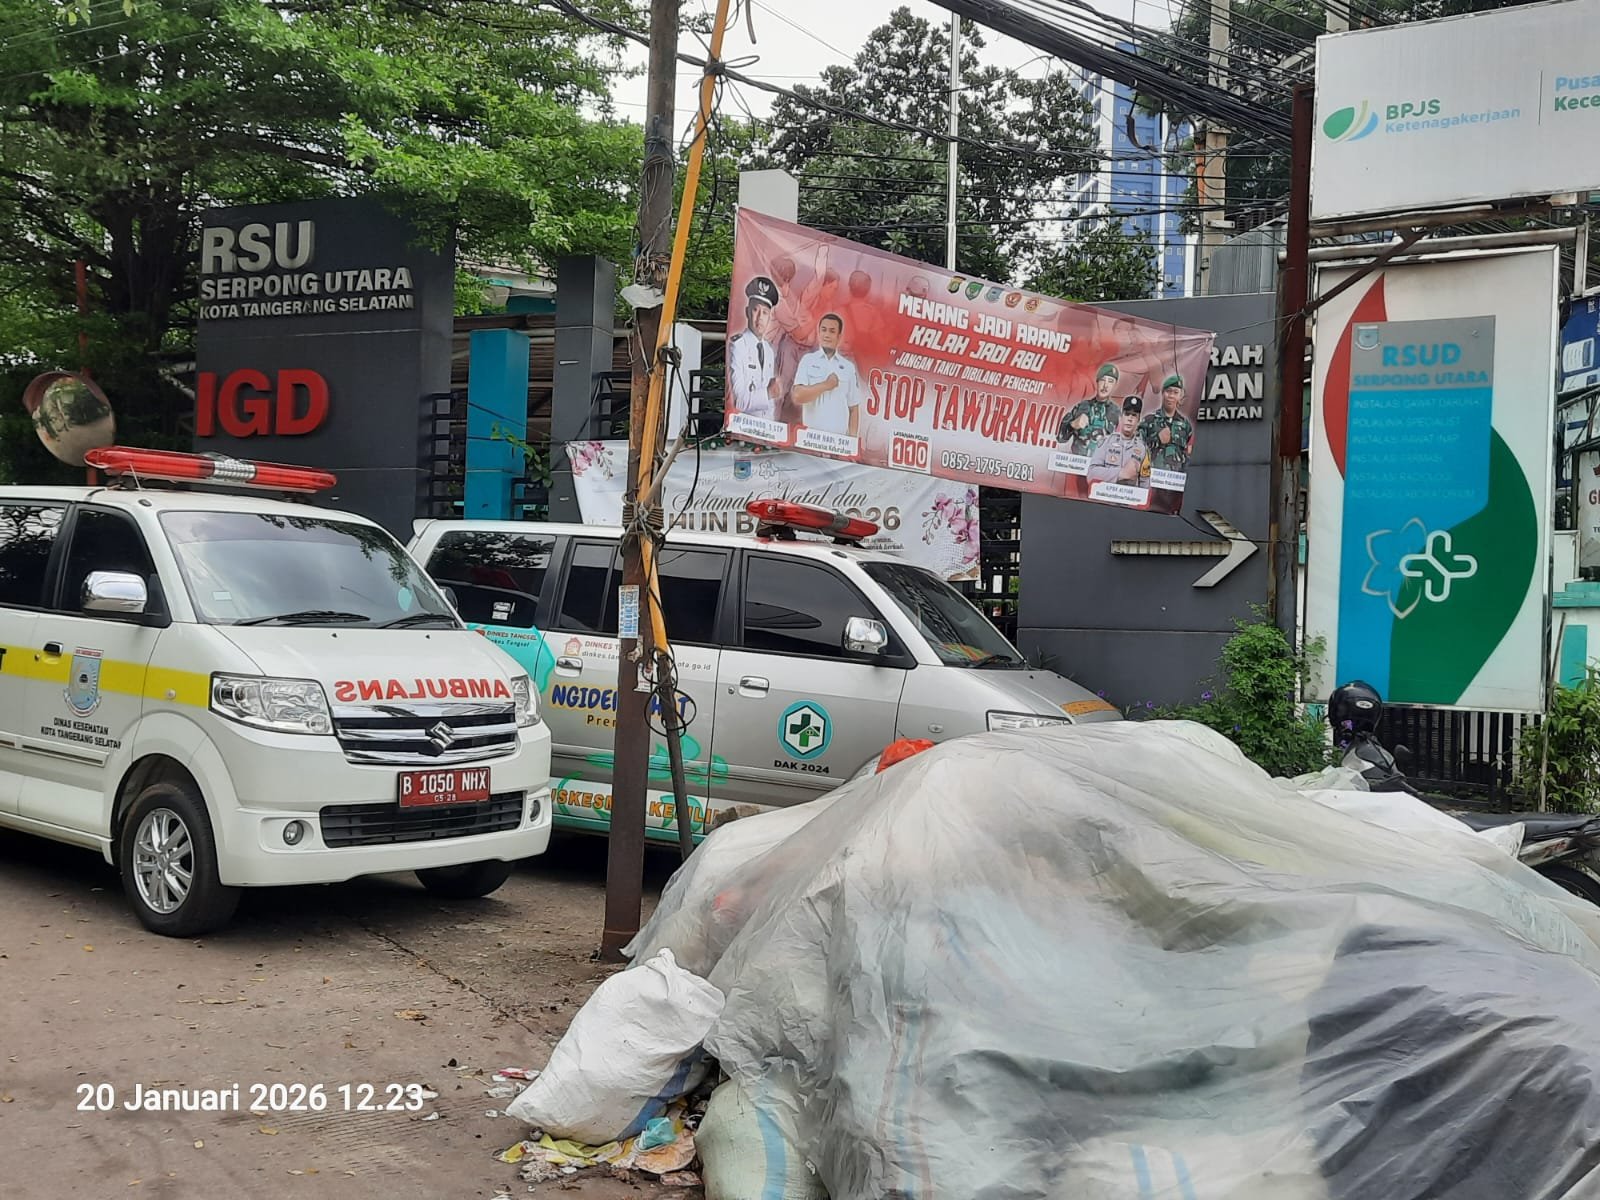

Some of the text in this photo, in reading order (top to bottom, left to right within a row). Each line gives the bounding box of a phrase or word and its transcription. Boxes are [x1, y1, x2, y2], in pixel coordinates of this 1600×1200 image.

[1385, 107, 1521, 134] Ketenagakerjaan
[1386, 99, 1441, 120] BPJS
[202, 220, 314, 274] RSU
[201, 267, 414, 300] SERPONG UTARA
[200, 294, 414, 319] KOTA TANGERANG SELATAN
[898, 293, 1072, 354] MENANG JADI ARANG
[908, 325, 1047, 373] KALAH JADI ABU
[1381, 343, 1462, 367] RSUD
[933, 359, 963, 378] TAKUT
[961, 364, 1002, 386] DIBILANG
[1353, 370, 1489, 387] SERPONG UTARA
[195, 367, 330, 438] IGD
[867, 368, 1066, 449] STOP TAWURAN!!!
[893, 440, 928, 467] 110
[941, 450, 1035, 482] 0852-1795-0281
[831, 481, 868, 507] dan
[584, 640, 613, 650] DINKES
[40, 726, 56, 737] KOTA
[57, 729, 94, 744] TANGERANG
[53, 717, 109, 735] DINAS KESEHATAN
[773, 759, 829, 775] DAK 2024
[403, 770, 487, 795] B 1050 NHX
